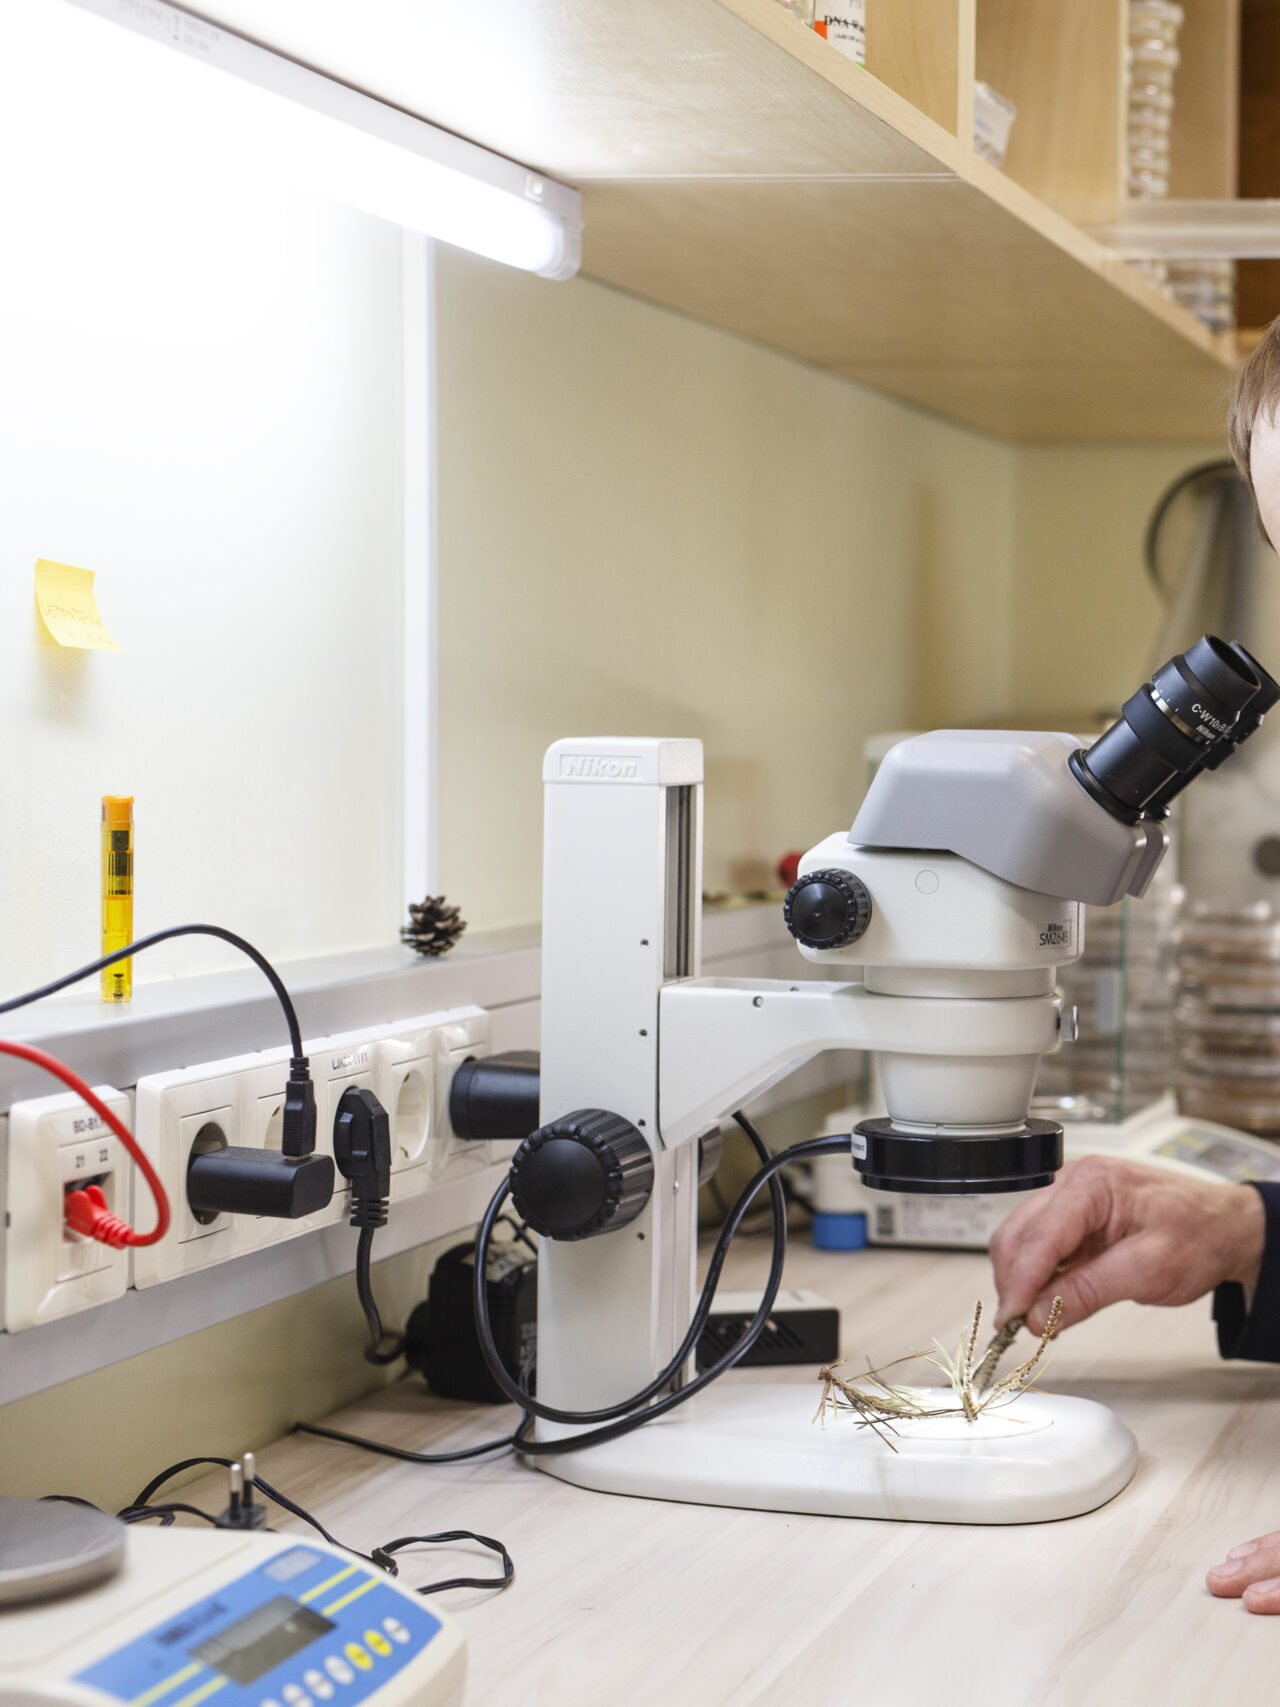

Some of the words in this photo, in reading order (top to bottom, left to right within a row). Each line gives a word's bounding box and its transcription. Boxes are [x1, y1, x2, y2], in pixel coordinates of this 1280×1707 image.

[824, 15, 849, 29] DNA
[1195, 724, 1216, 740] Nikon
[565, 755, 638, 778] Nikon
[1047, 923, 1064, 932] Nikon
